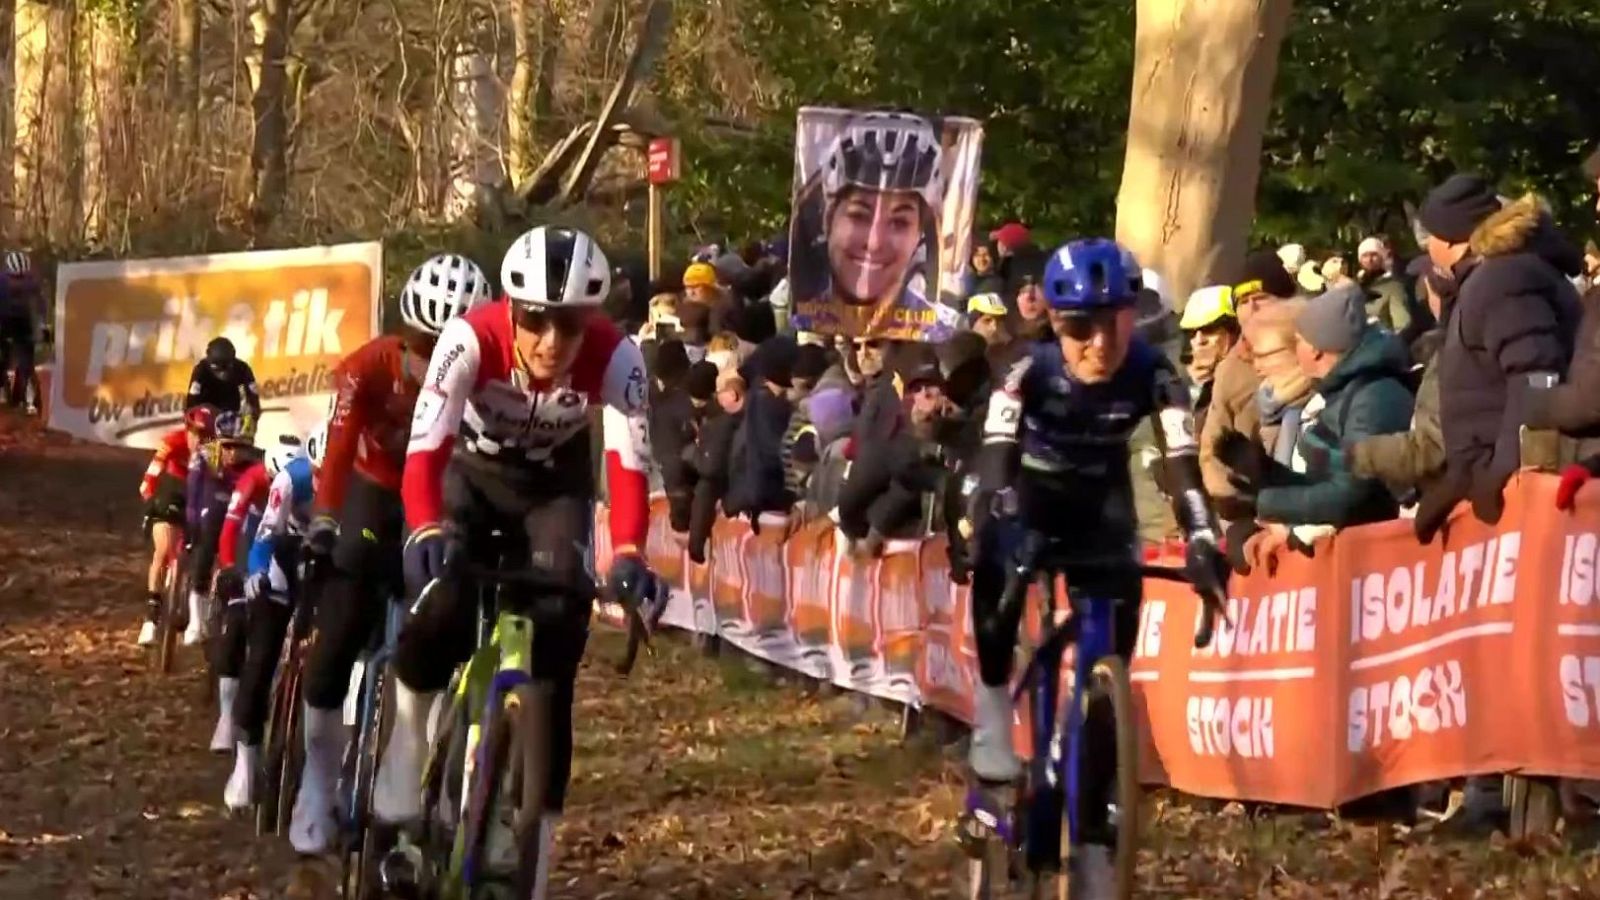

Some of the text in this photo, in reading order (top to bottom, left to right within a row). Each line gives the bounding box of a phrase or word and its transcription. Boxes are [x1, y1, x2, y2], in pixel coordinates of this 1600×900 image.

[1350, 531, 1521, 645] ISOLATIE
[1186, 696, 1275, 759] STOCK
[1347, 660, 1468, 752] STOCK
